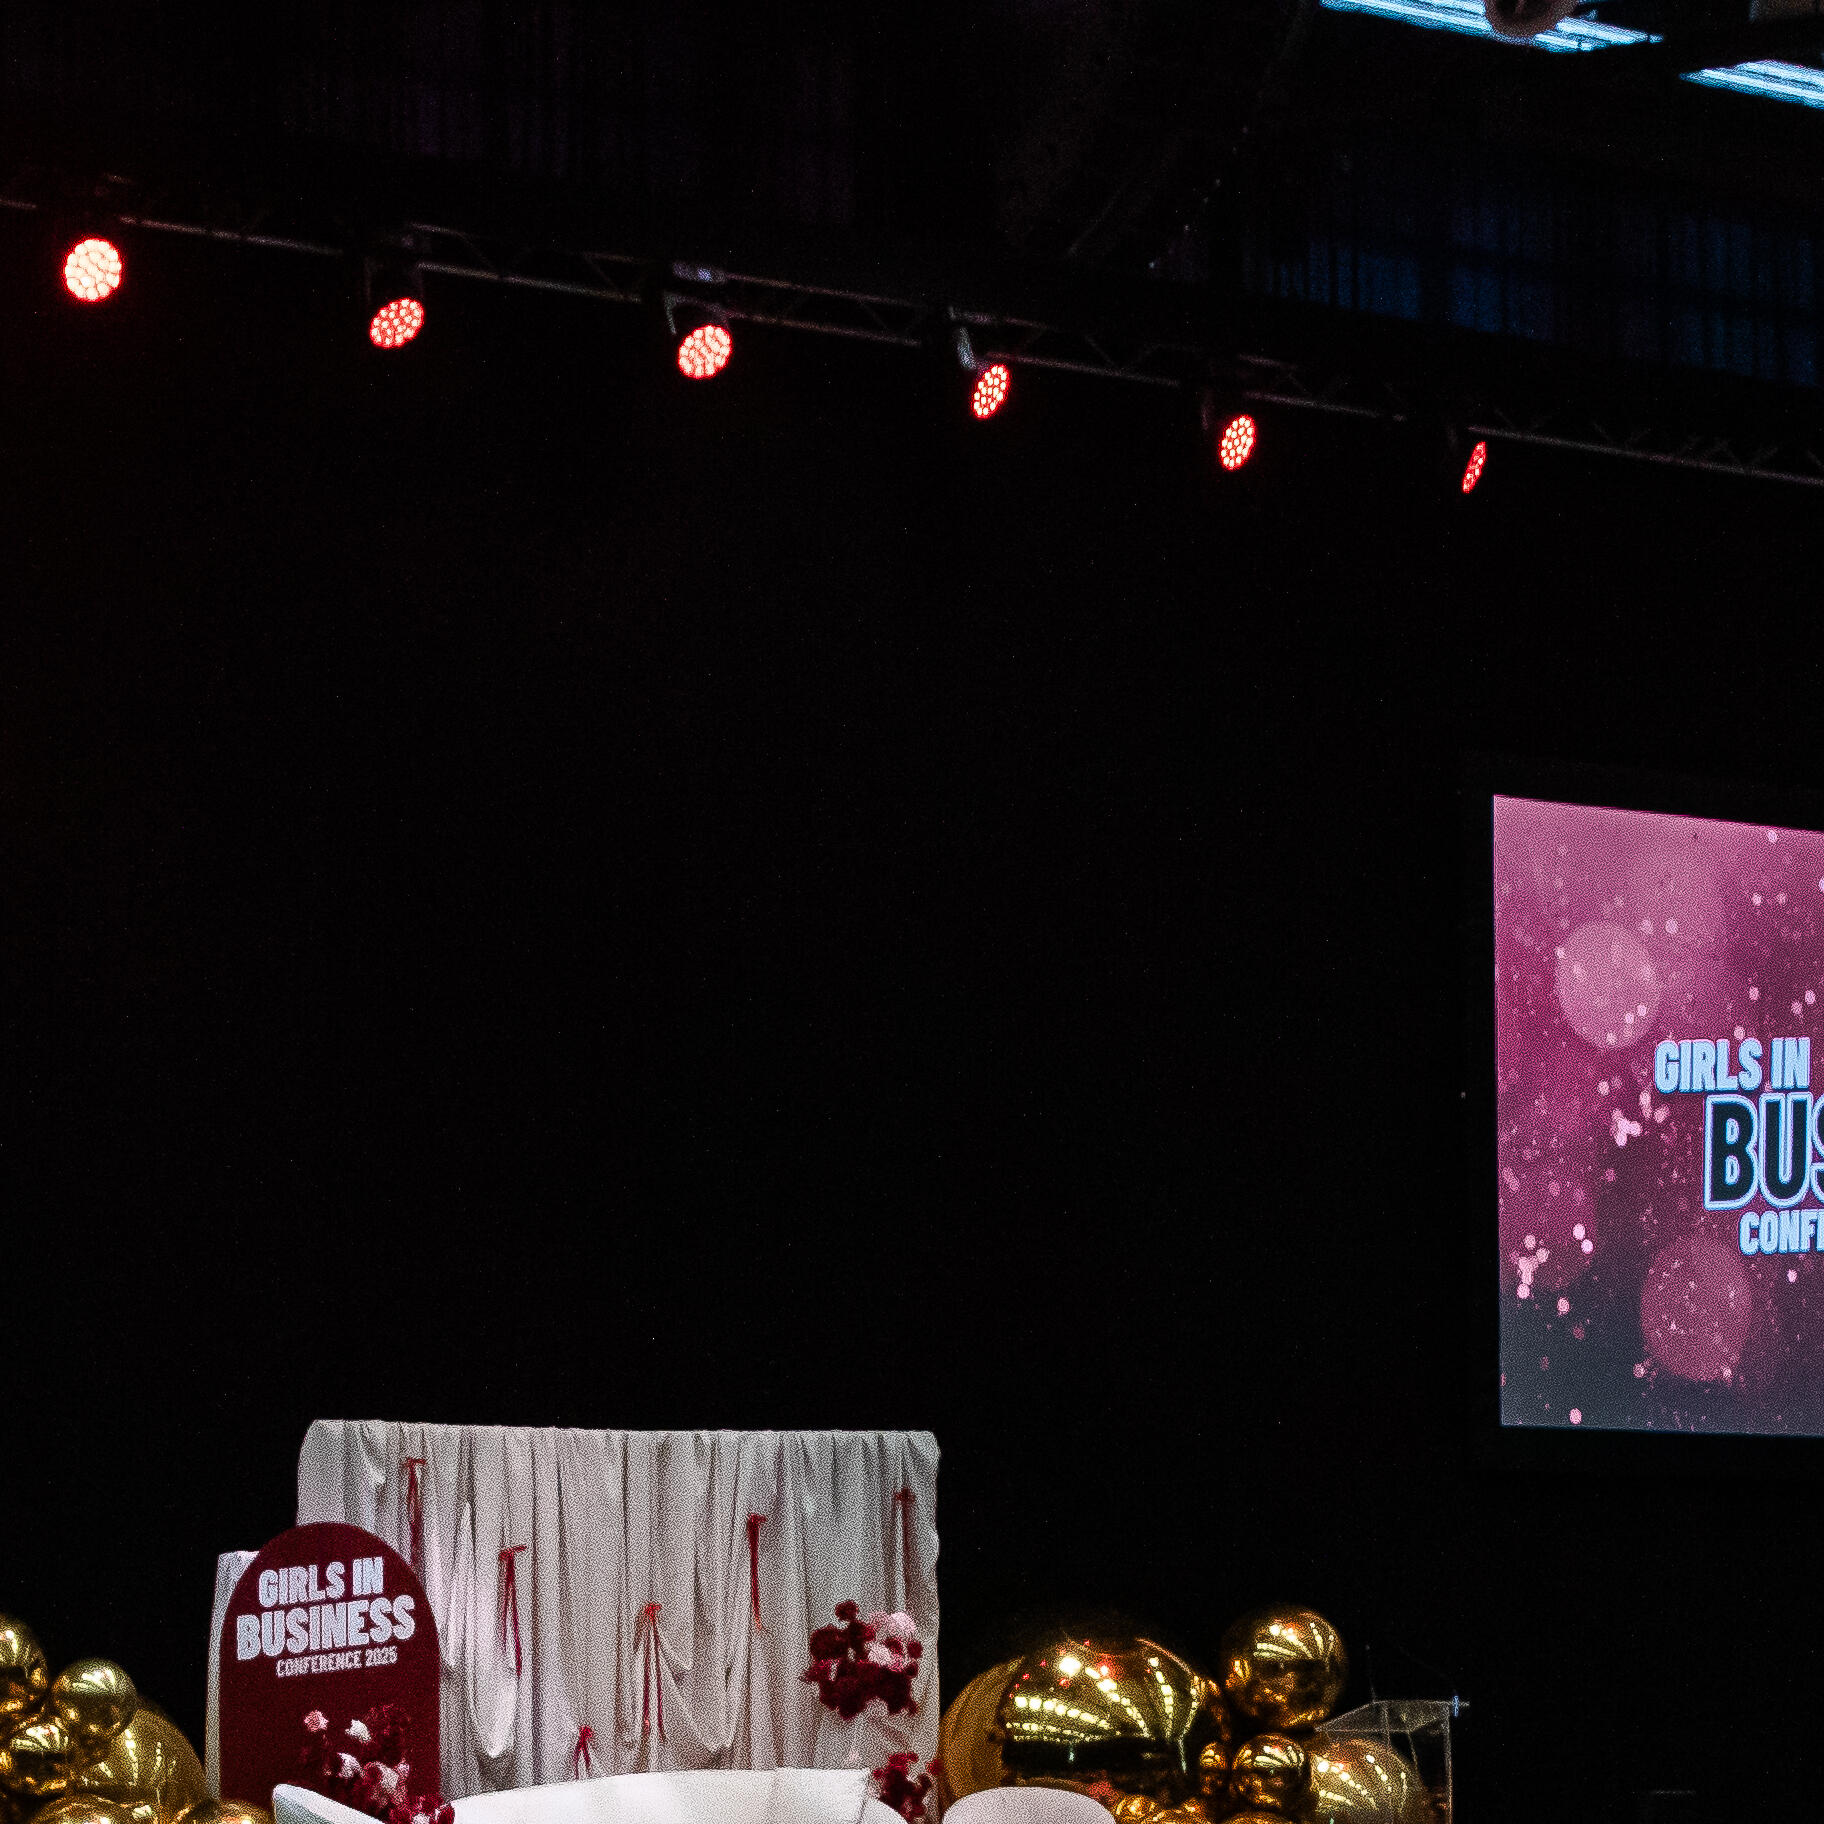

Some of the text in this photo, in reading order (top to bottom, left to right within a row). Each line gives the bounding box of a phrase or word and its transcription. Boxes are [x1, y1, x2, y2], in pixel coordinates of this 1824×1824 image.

[1654, 1036, 1812, 1093] GIRLS IN
[258, 1556, 384, 1608] GIRLS IN
[236, 1594, 416, 1661] BUSINESS
[276, 1646, 398, 1678] CONFERENCE 2025
